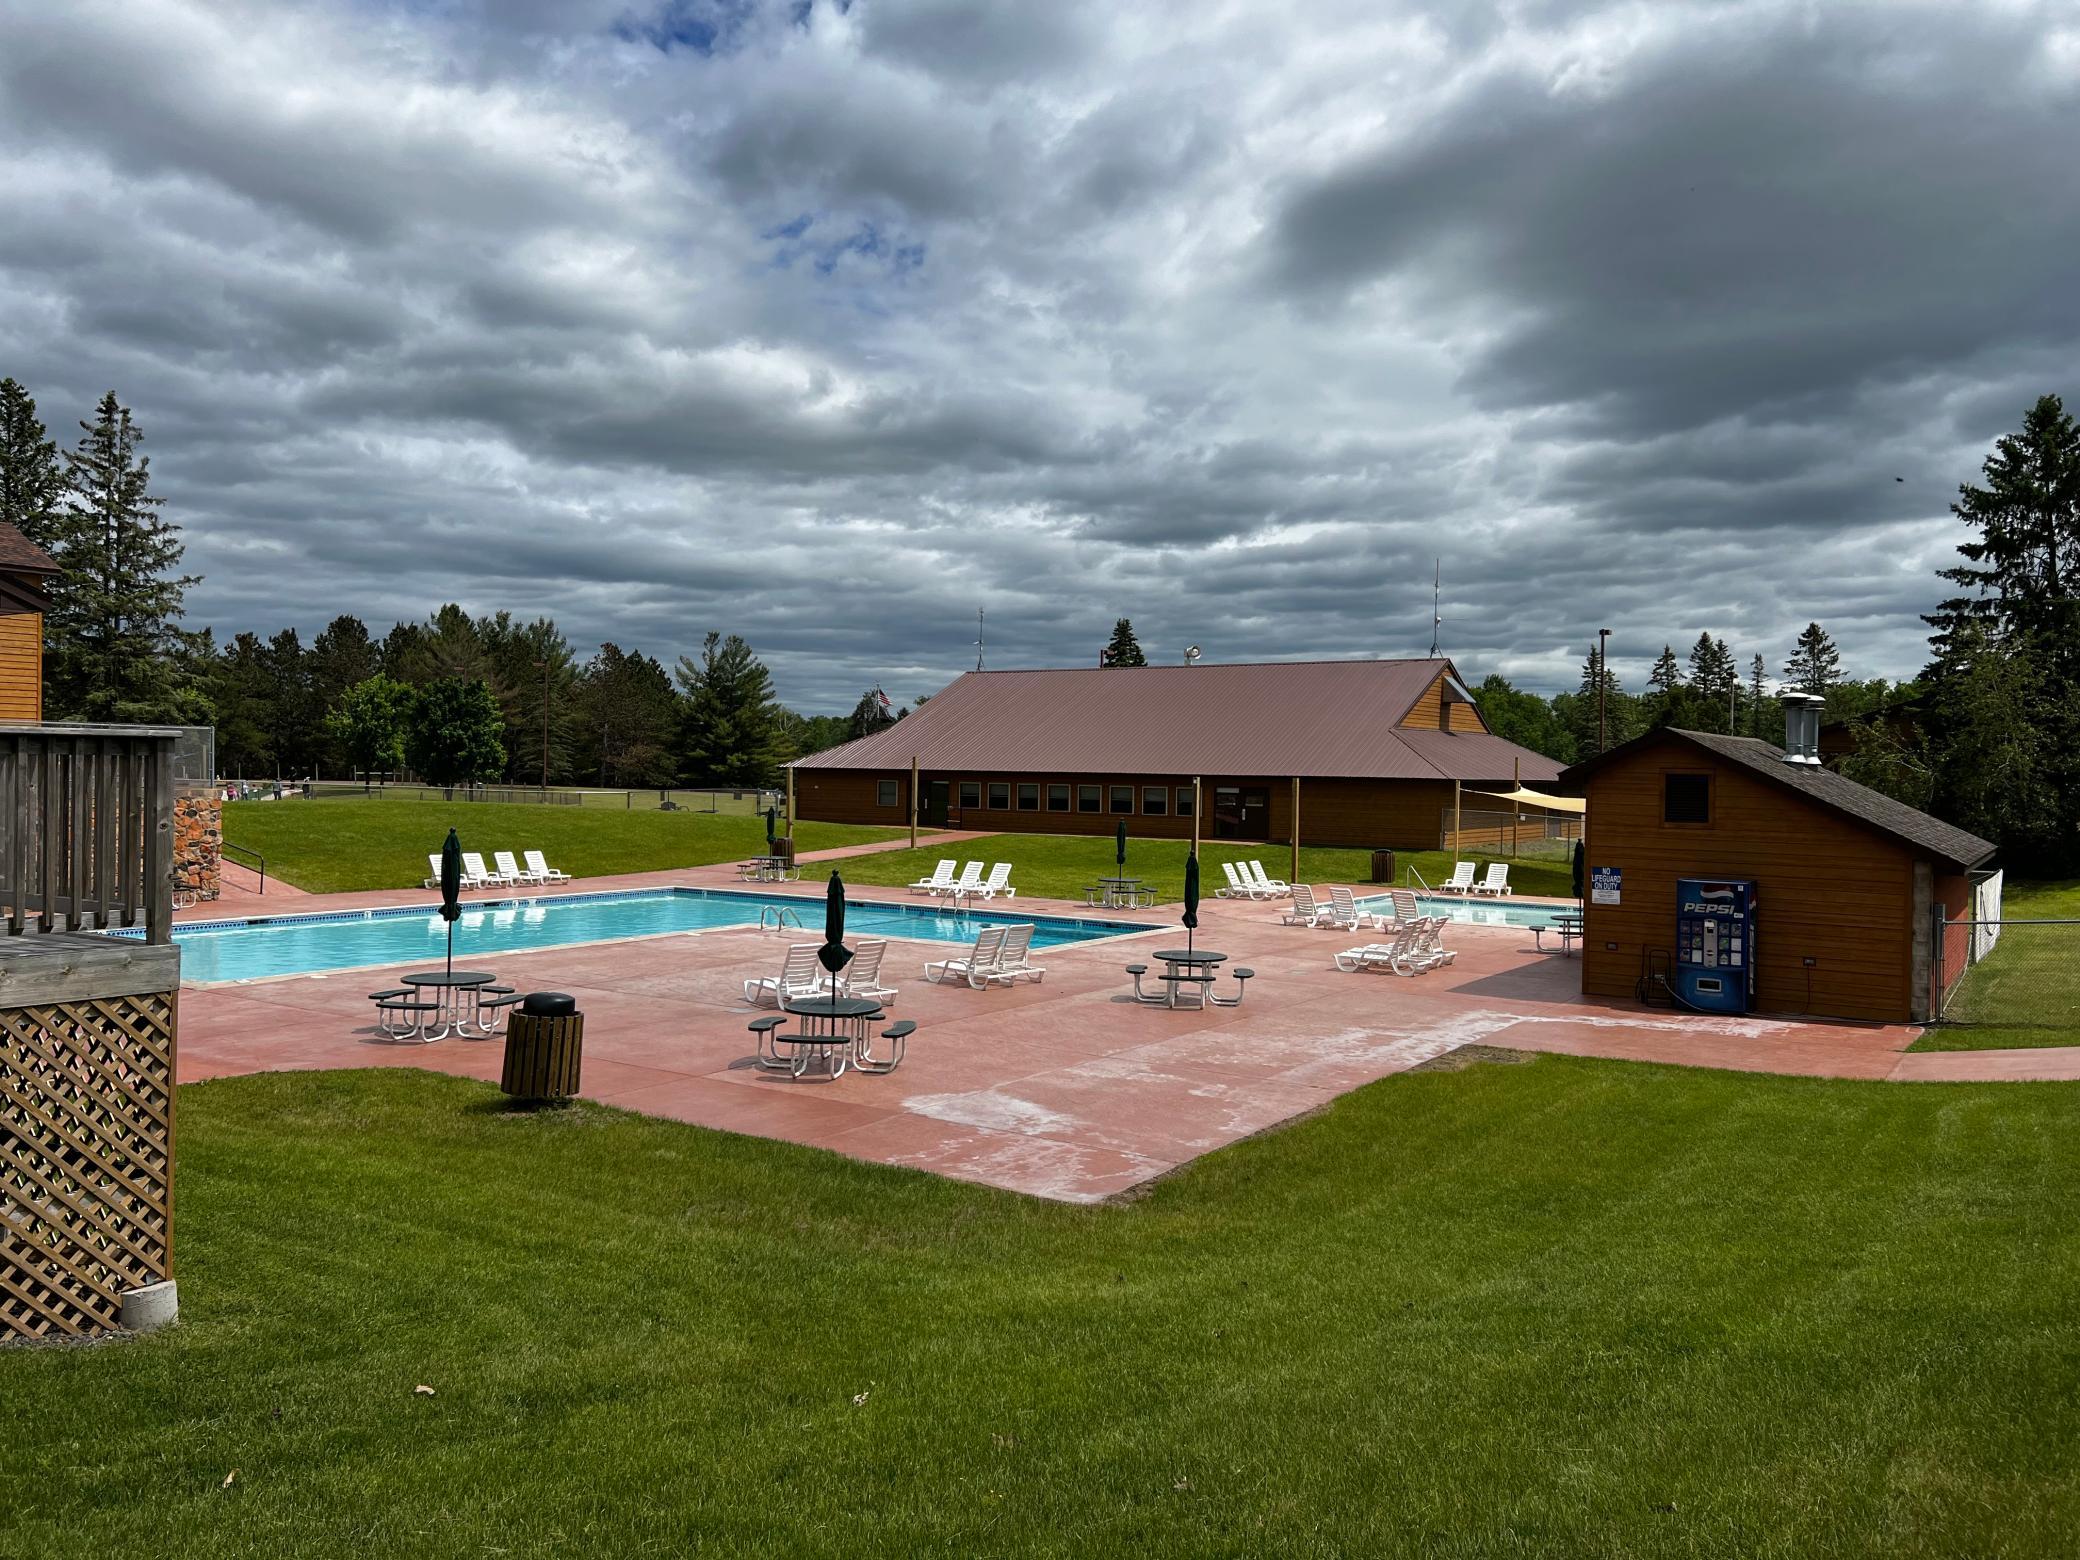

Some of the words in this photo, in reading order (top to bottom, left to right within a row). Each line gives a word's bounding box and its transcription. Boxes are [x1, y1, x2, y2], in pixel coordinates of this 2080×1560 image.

[1602, 867, 1611, 875] NO
[1592, 874, 1621, 883] LIFEGUARD
[1603, 882, 1617, 890] DUTY
[1684, 902, 1735, 915] PEPSI
